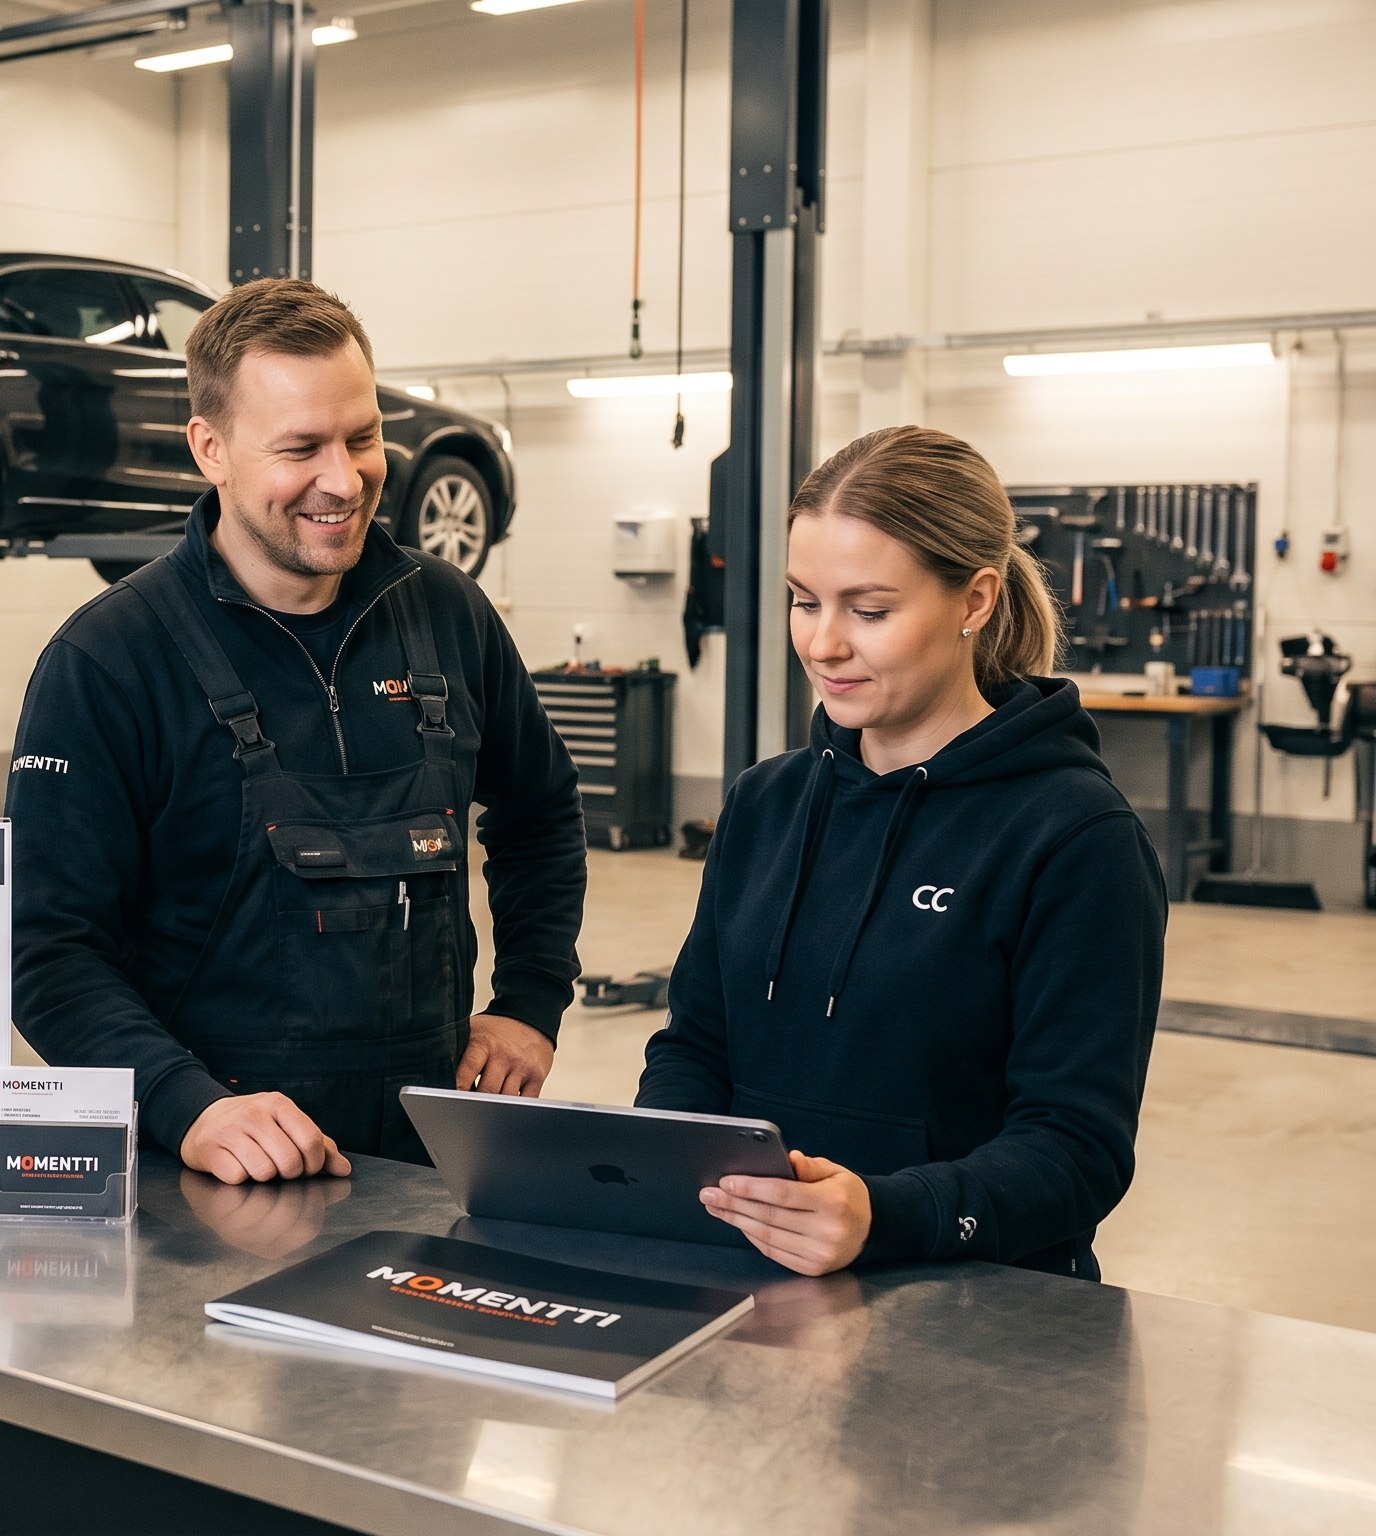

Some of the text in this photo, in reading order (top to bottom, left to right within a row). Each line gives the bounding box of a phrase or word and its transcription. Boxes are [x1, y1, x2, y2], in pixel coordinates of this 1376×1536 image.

[912, 885, 955, 912] CC
[2, 1080, 63, 1090] MOMENTTI
[6, 1155, 99, 1171] MOMENTTI
[366, 1266, 622, 1328] MOMENTTI
